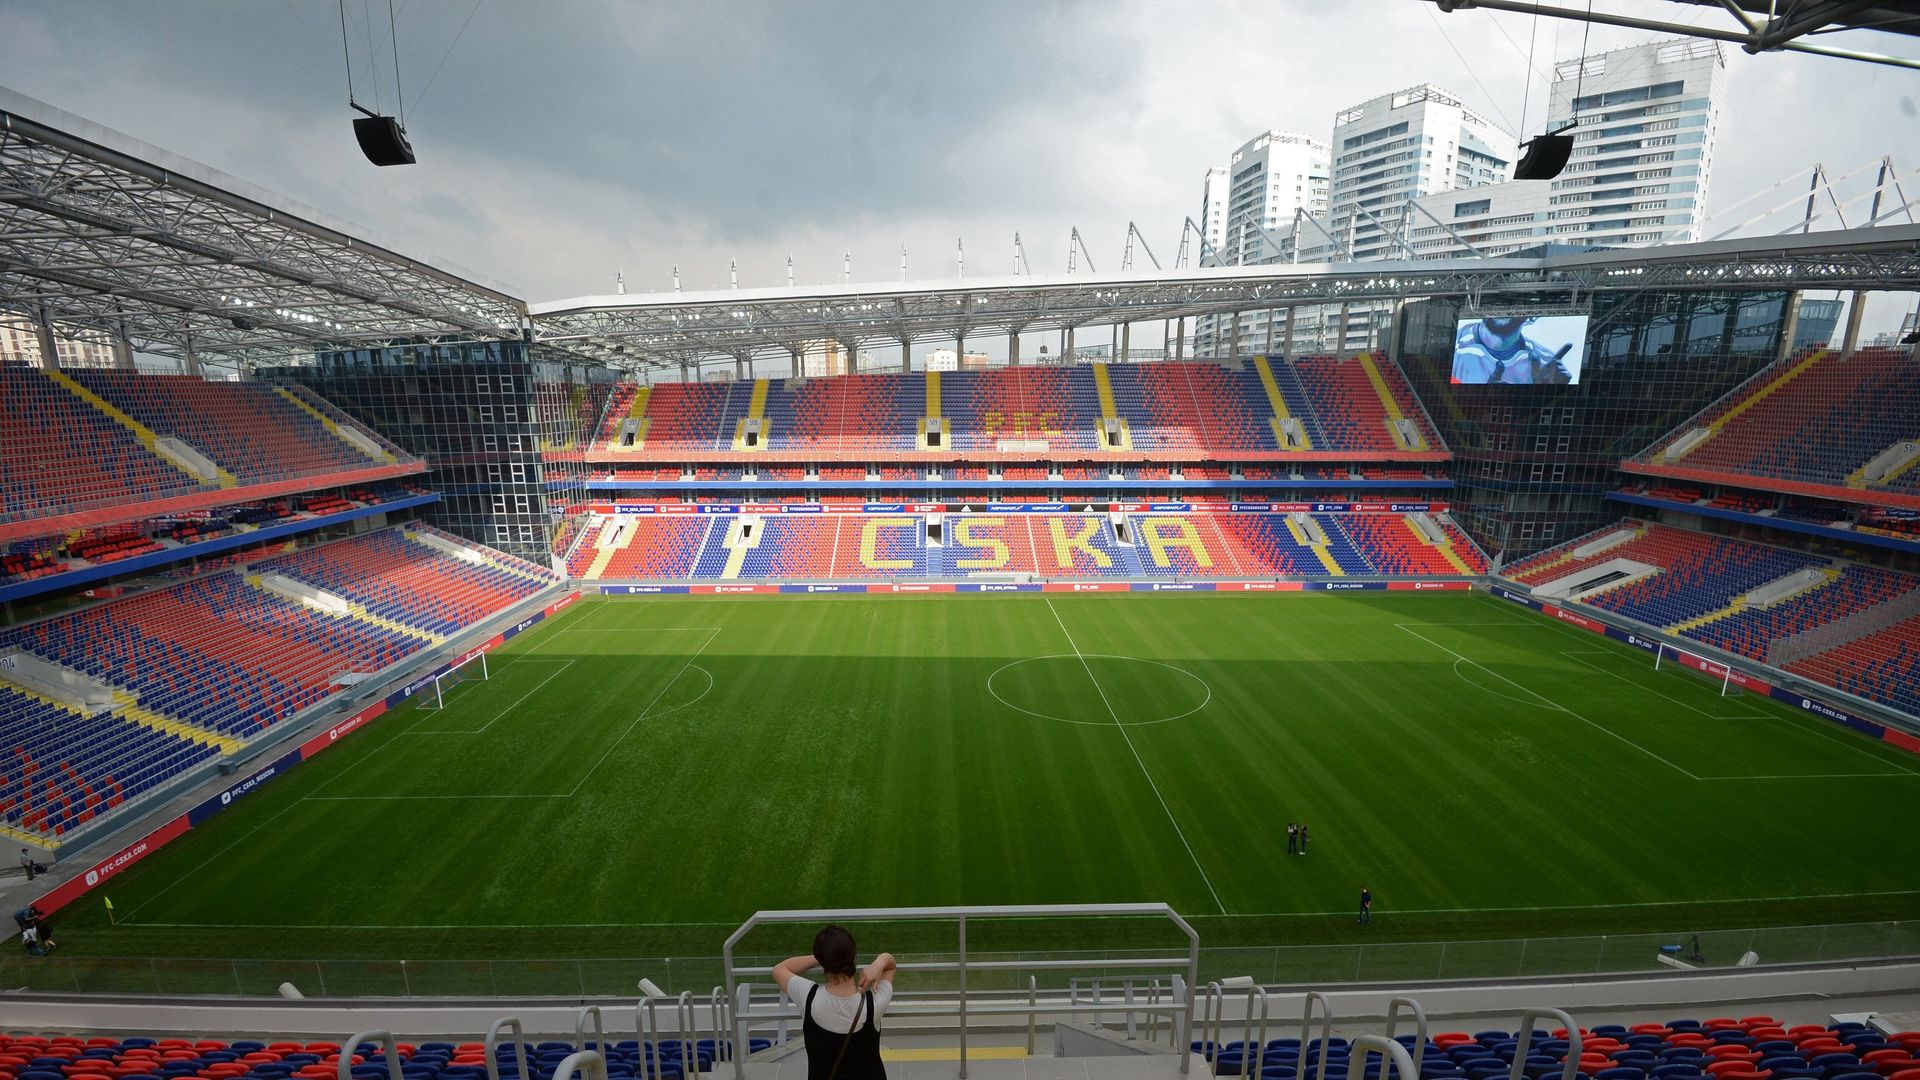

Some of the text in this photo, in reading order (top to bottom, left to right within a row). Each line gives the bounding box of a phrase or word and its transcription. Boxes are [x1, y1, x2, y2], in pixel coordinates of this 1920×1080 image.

[859, 516, 1213, 569] CSKA
[1812, 704, 1847, 721] PFC-CSKA.COM
[231, 767, 275, 797] PFC_CSKA_MOSCOW
[100, 843, 147, 875] PFC-CSKA.COM
